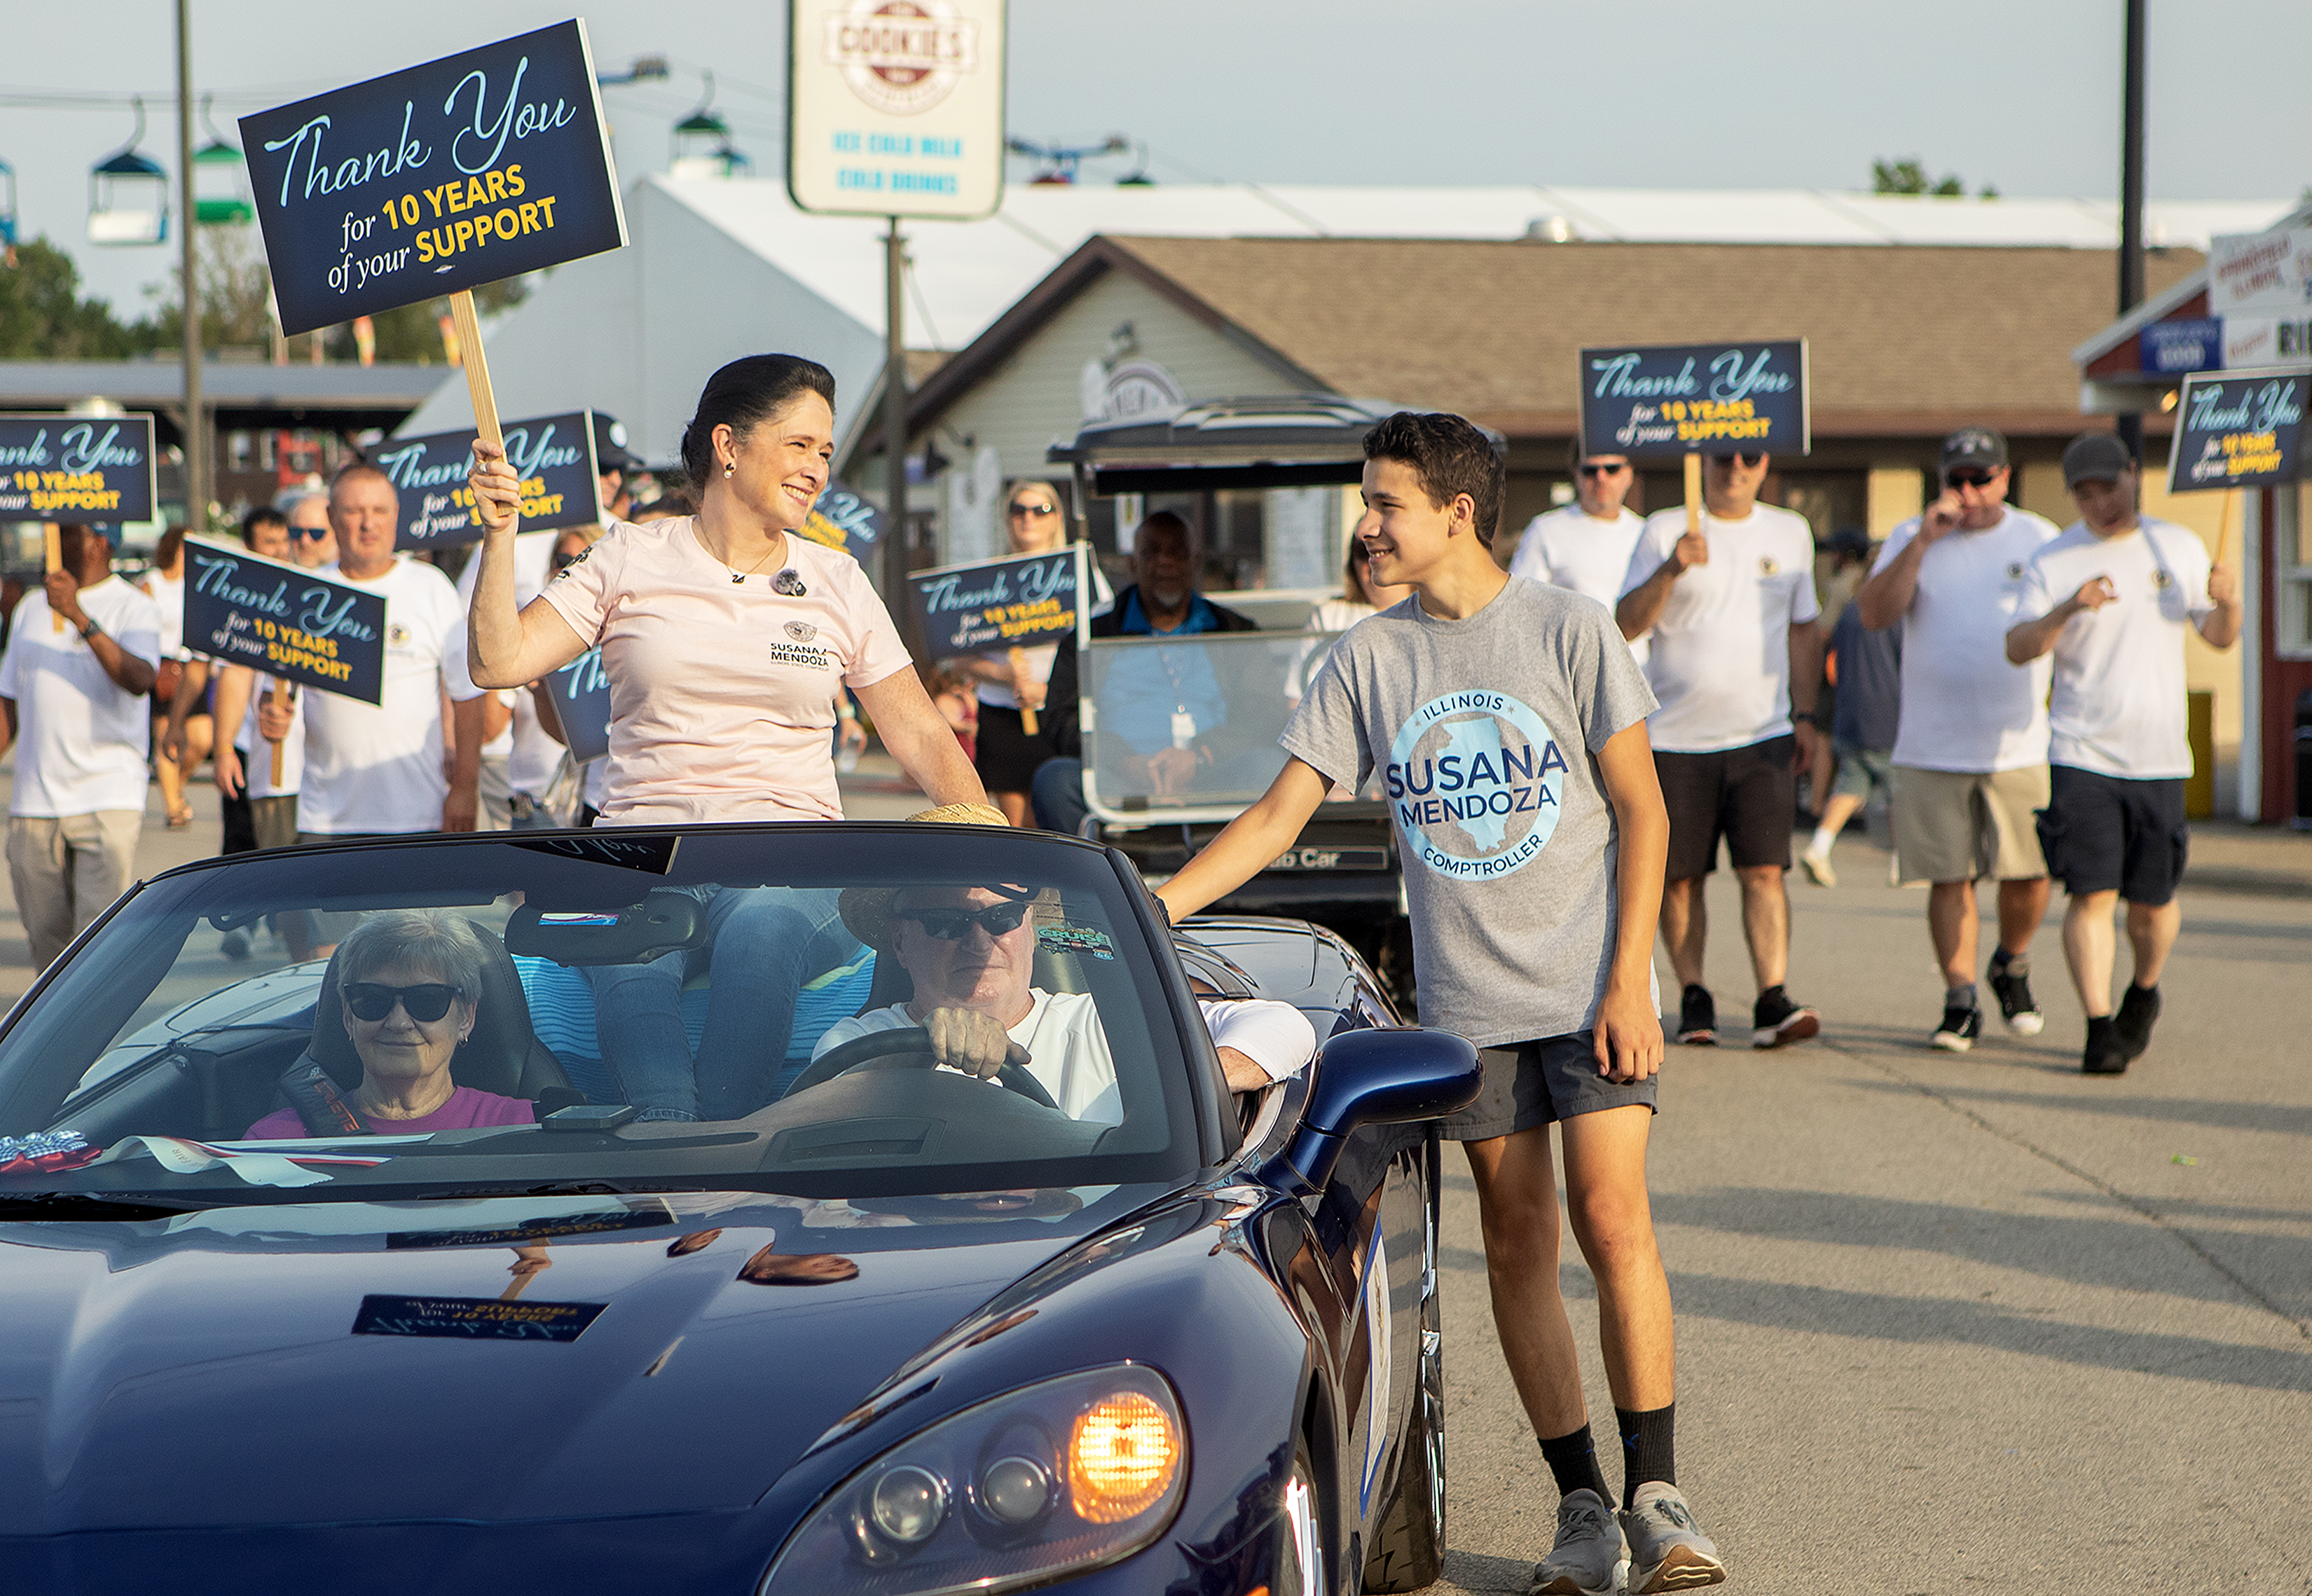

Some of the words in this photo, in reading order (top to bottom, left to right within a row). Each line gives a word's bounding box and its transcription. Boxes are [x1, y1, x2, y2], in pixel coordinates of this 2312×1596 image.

[839, 25, 961, 57] COOKIES
[263, 100, 432, 207] Thank
[444, 56, 577, 174] You
[340, 212, 377, 253] for
[382, 194, 420, 230] 10
[423, 164, 526, 217] YEARS
[328, 254, 352, 294] of
[357, 247, 411, 289] your
[415, 196, 556, 264] SUPPORT
[2278, 321, 2312, 357] RI
[1591, 352, 1702, 399] Thank
[1709, 348, 1796, 406] You
[1660, 400, 1687, 422] 10
[1688, 398, 1755, 421] YEARS
[2188, 383, 2253, 432] Thank
[1677, 417, 1772, 441] SUPPORT
[60, 423, 144, 476] You
[13, 470, 39, 490] 10
[40, 470, 105, 490] YEARS
[29, 490, 121, 510] SUPPORT
[422, 492, 449, 516] for
[193, 554, 292, 617] Thank
[298, 586, 377, 642] You
[920, 570, 1014, 614] Thank
[223, 610, 252, 631] for
[253, 617, 277, 640] 10
[277, 624, 339, 659] YEARS
[983, 606, 1007, 624] 10
[211, 628, 233, 649] of
[228, 635, 266, 656] your
[266, 641, 353, 682] SUPPORT
[771, 642, 819, 654] SUSANA
[771, 652, 829, 666] MENDOZA
[1423, 694, 1504, 720] ILLINOIS
[1386, 740, 1569, 799] SUSANA
[1401, 783, 1557, 827] MENDOZA
[1300, 848, 1341, 868] Car
[1424, 834, 1543, 876] COMPTROLLER
[1038, 929, 1108, 944] CRUISE
